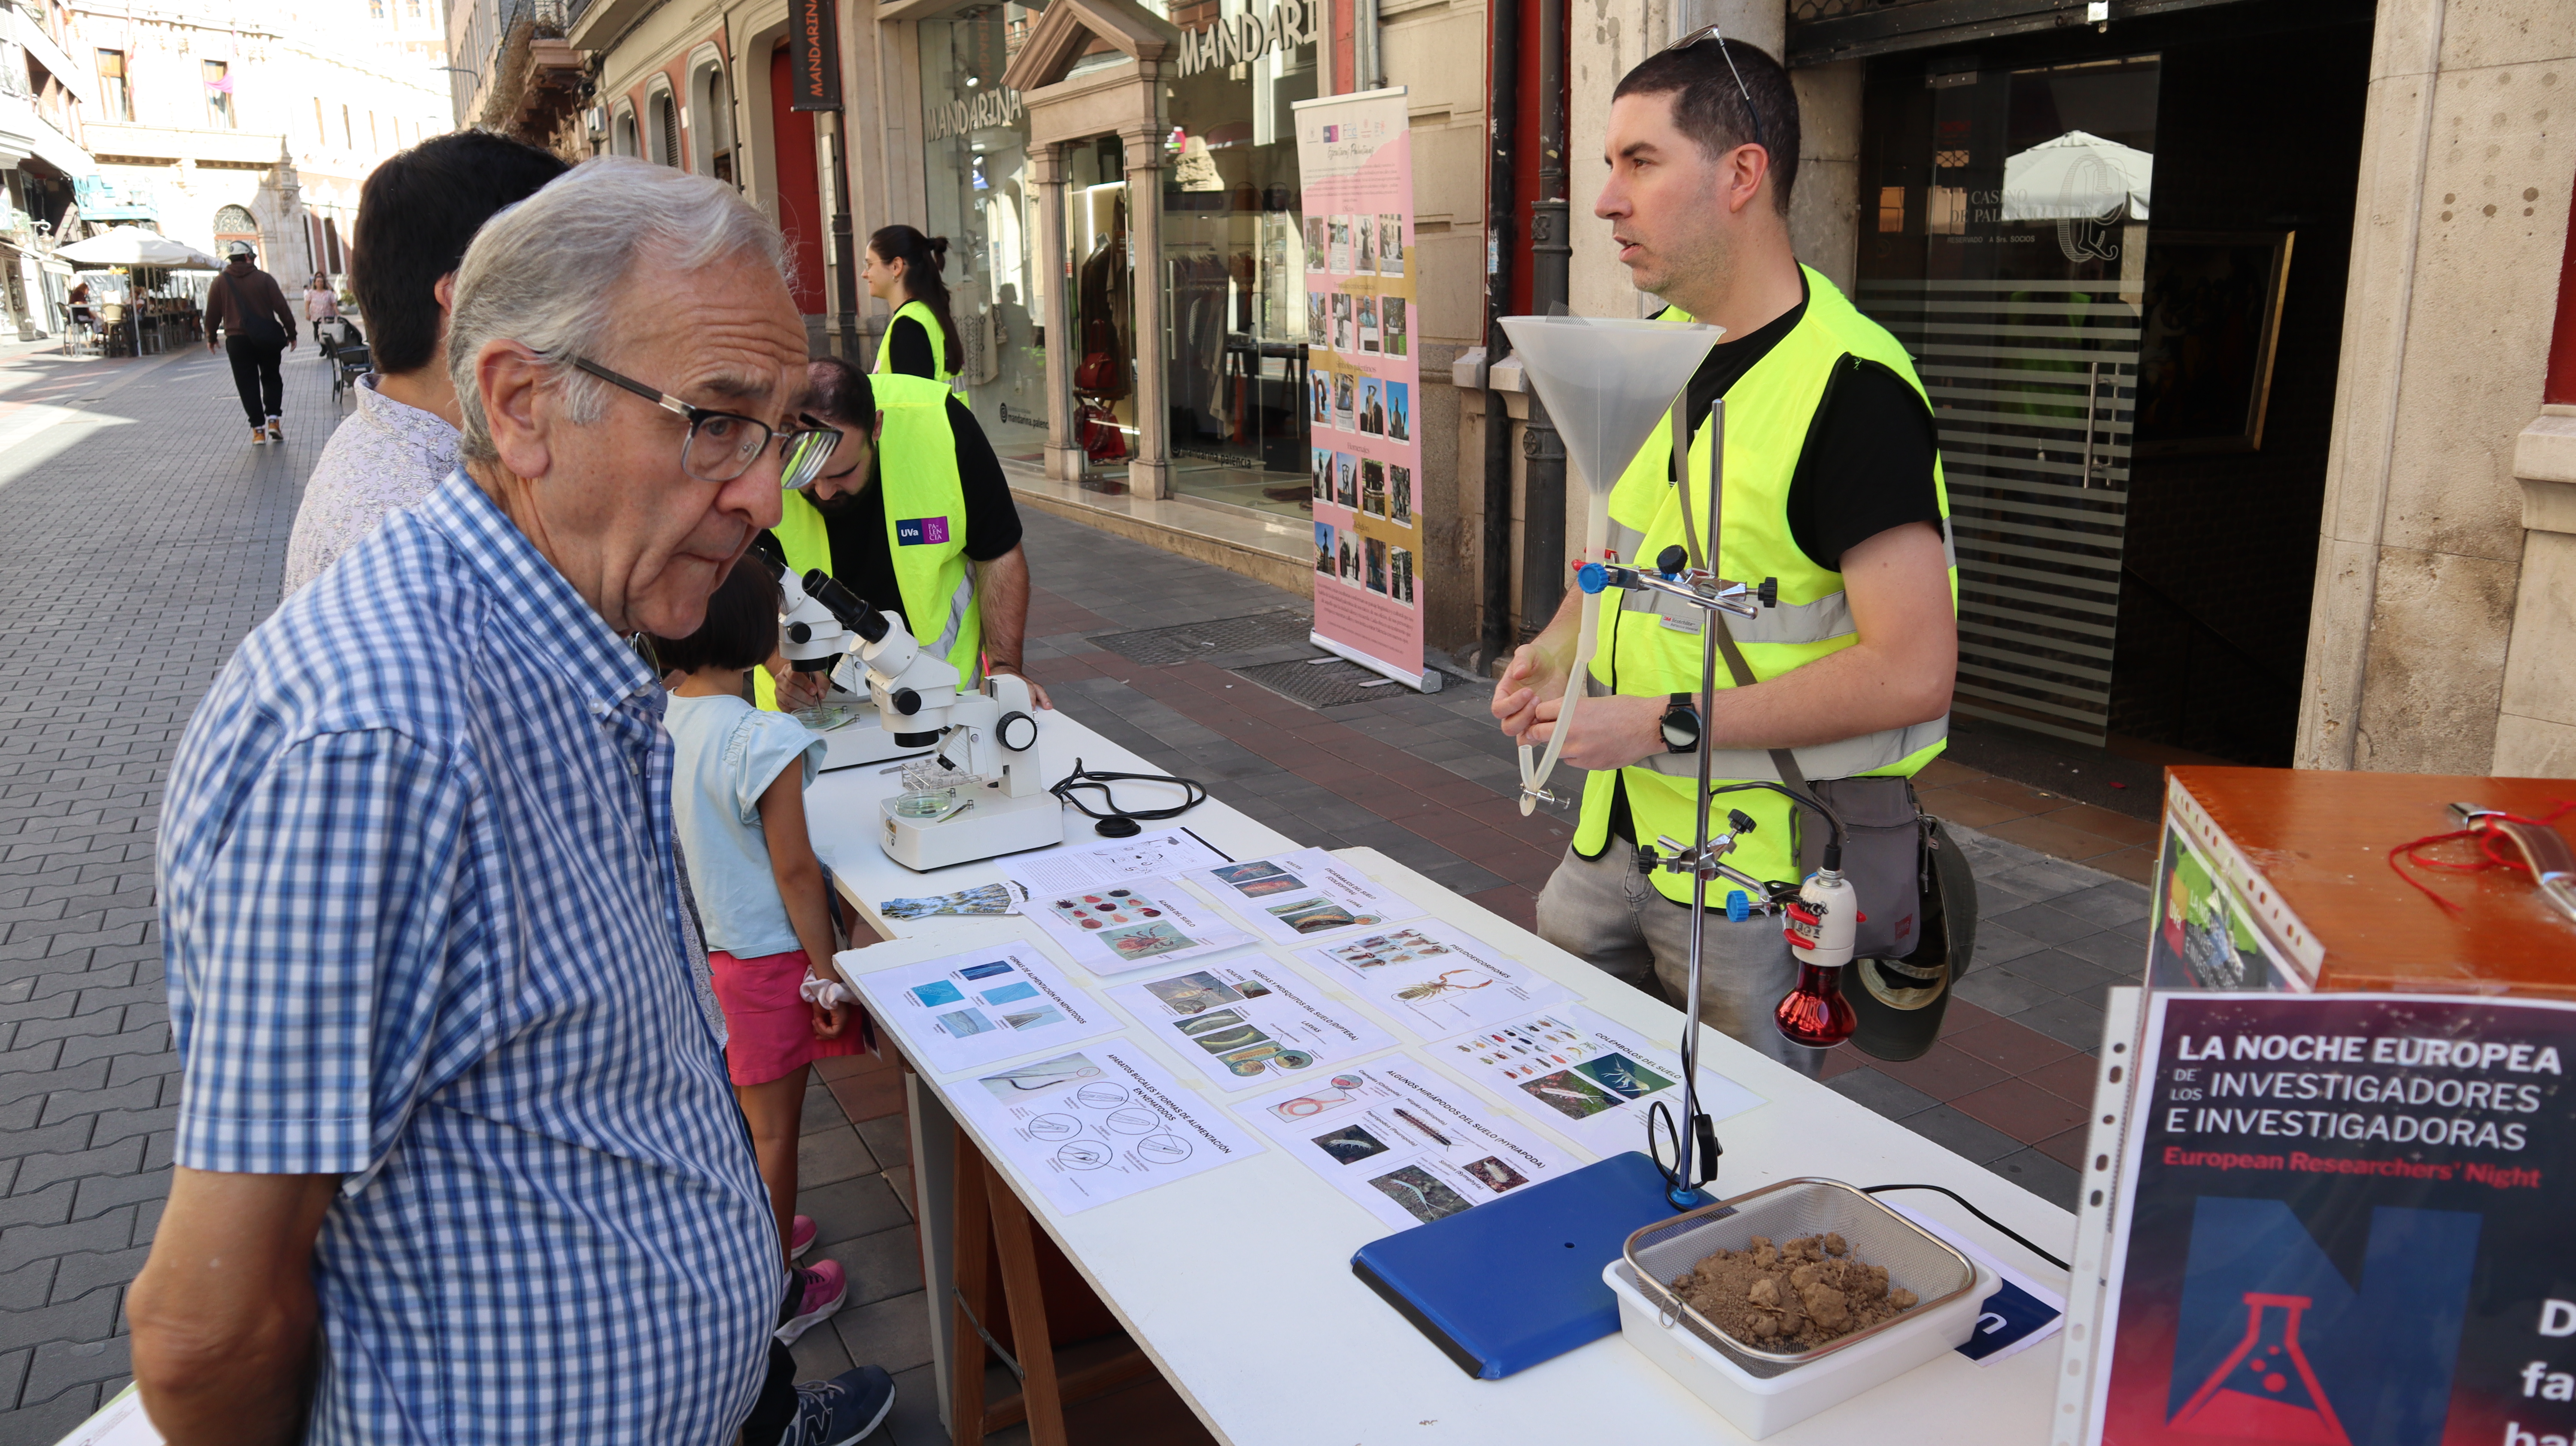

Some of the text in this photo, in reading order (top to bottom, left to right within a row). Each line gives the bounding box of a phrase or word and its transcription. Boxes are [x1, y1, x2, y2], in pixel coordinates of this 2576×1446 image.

[928, 85, 1022, 142] MANDARINA
[1971, 188, 2028, 205] CASINO
[1951, 209, 1968, 223] DE
[1947, 235, 1983, 243] RESERVADO
[2010, 234, 2035, 243] SOCIOS
[1347, 442, 1370, 454] Homenajes
[901, 528, 919, 537] UVa
[1285, 860, 1304, 869] ADULTOS
[1322, 868, 1357, 886] ESCARABAJOS
[1359, 891, 1378, 899] SUELO
[1323, 876, 1359, 895] (COLEOPTERA)
[1157, 899, 1178, 911] ÁCAROS
[1179, 916, 1197, 927] SUELO
[1345, 899, 1364, 908] LARVAS
[1224, 968, 1247, 981] ADULTOS
[1446, 944, 1513, 978] PSEUDOESCORPIONES
[1007, 955, 1026, 968] FORMAS
[1025, 972, 1059, 997] ALIMENTACIÓN
[1057, 1001, 1088, 1024] NEMATODOS
[1249, 969, 1274, 983] MOSCAS
[1271, 984, 1308, 1006] MOSQUITOS
[1312, 1012, 1334, 1023] SUELO
[1327, 1022, 1360, 1041] (DIPTERA)
[1300, 1020, 1322, 1033] LARVAS
[1592, 1032, 1647, 1059] COLÉMBOLOS
[1654, 1065, 1683, 1079] SUELO
[2178, 1034, 2562, 1075] LA NOCHE EUROPEA
[1356, 1069, 1403, 1097] Ciempiés (Chilopoda)
[2173, 1069, 2197, 1082] DE
[1106, 1054, 1135, 1073] APARATOS
[1129, 1072, 1158, 1093] BUCALES
[1156, 1095, 1184, 1113] FORMAS
[1184, 1118, 1234, 1154] ALIMENTACIÓN
[2170, 1088, 2202, 1101] LOS
[2210, 1072, 2541, 1113] INVESTIGADORES
[1139, 1094, 1177, 1121] NEMATODOS
[1385, 1069, 1548, 1169] ALGUNOS MIRIÁPODOS DEL SUELO (MYRIAPODA)
[1404, 1098, 1449, 1126] Milpiés (Diplopoda)
[1363, 1110, 1419, 1147] Paurópodos (Pauropoda)
[2166, 1108, 2528, 1151] E INVESTIGADORAS
[2163, 1146, 2284, 1171] European
[2464, 1162, 2542, 1189] Night
